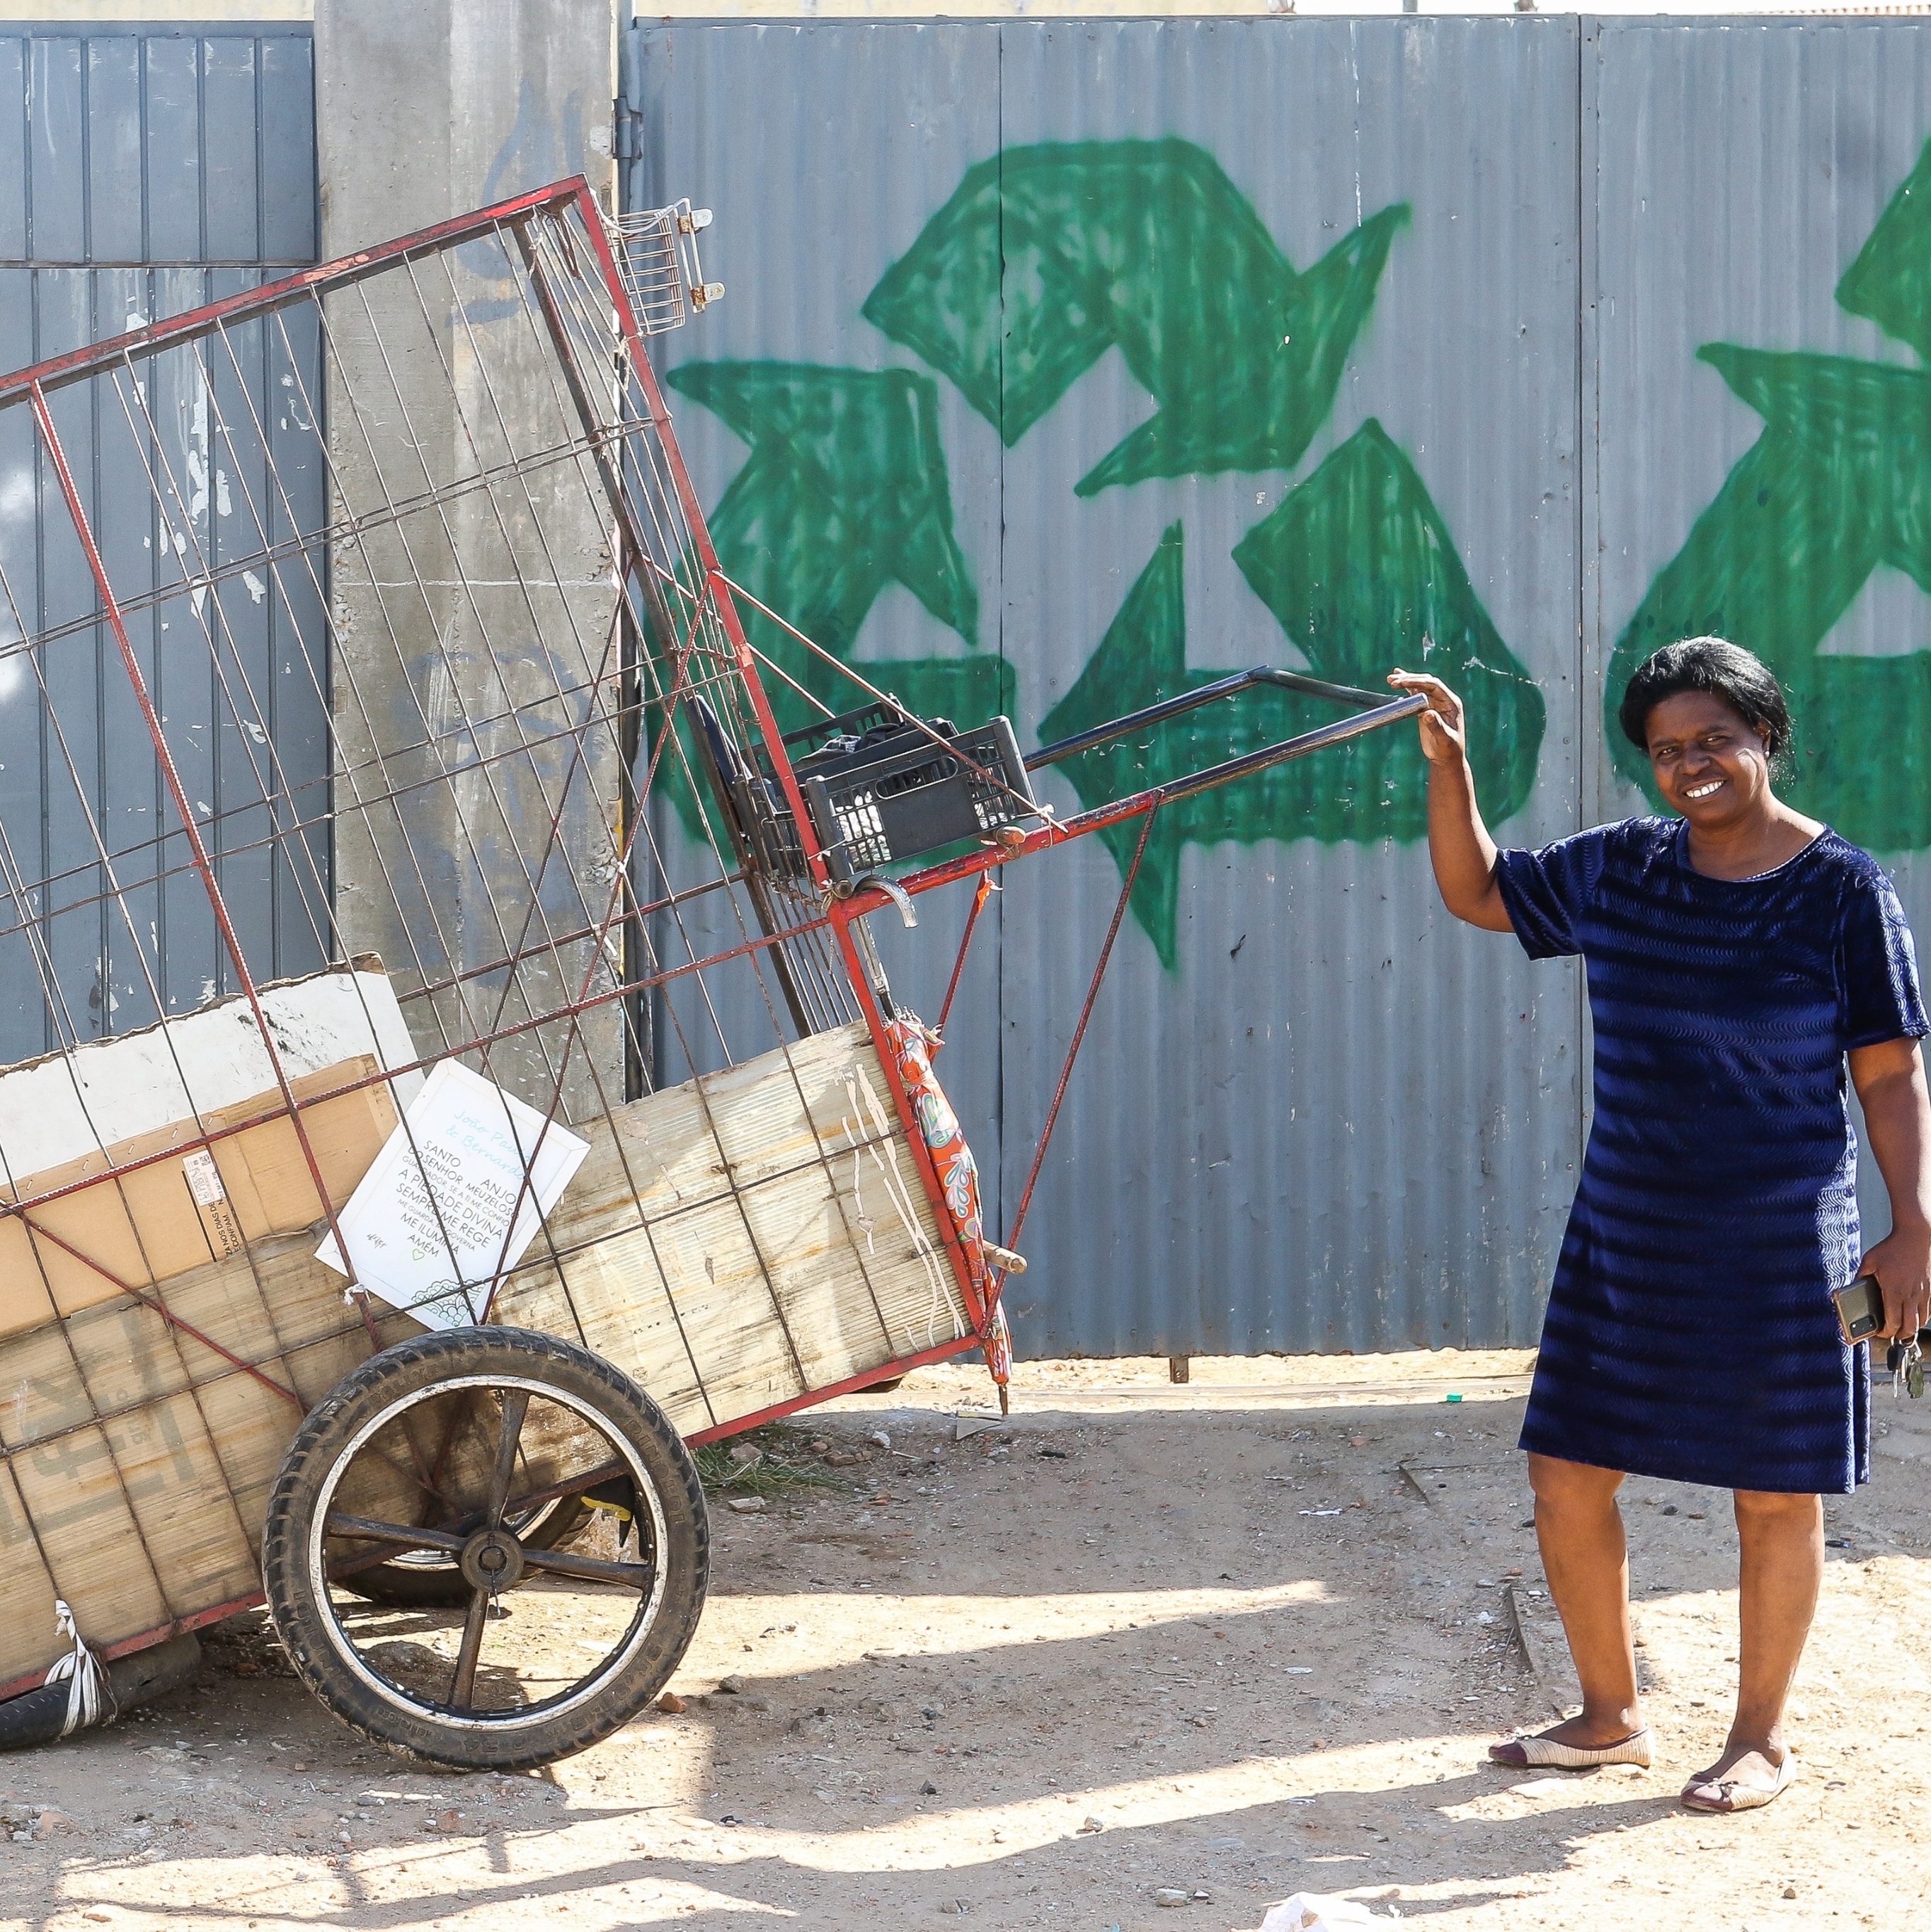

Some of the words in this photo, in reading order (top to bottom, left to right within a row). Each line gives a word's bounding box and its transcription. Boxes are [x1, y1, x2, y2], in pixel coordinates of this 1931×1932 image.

[446, 1125, 459, 1138] &
[422, 1154, 464, 1185] SENHOR
[465, 1183, 486, 1199] MEU
[423, 1140, 461, 1167] SANTO
[480, 1178, 517, 1204] ANJO
[212, 1212, 224, 1230] DIAS
[396, 1183, 441, 1216] SEMPRE
[440, 1211, 460, 1229] ME
[459, 1222, 491, 1248] REGE
[398, 1168, 408, 1180] A
[410, 1174, 464, 1213] PIEDADE
[462, 1207, 503, 1240] DIVINA
[400, 1212, 420, 1229] ME
[449, 1185, 459, 1195] SE
[470, 1200, 483, 1210] ME
[482, 1206, 510, 1227] CONFIO
[218, 1229, 229, 1246] NOS
[222, 1212, 239, 1248] CONFIAM.
[397, 1199, 408, 1209] ME
[408, 1205, 434, 1226] GUARDA,
[445, 1229, 475, 1251] GOVERNA
[407, 1234, 440, 1258] AMÉM
